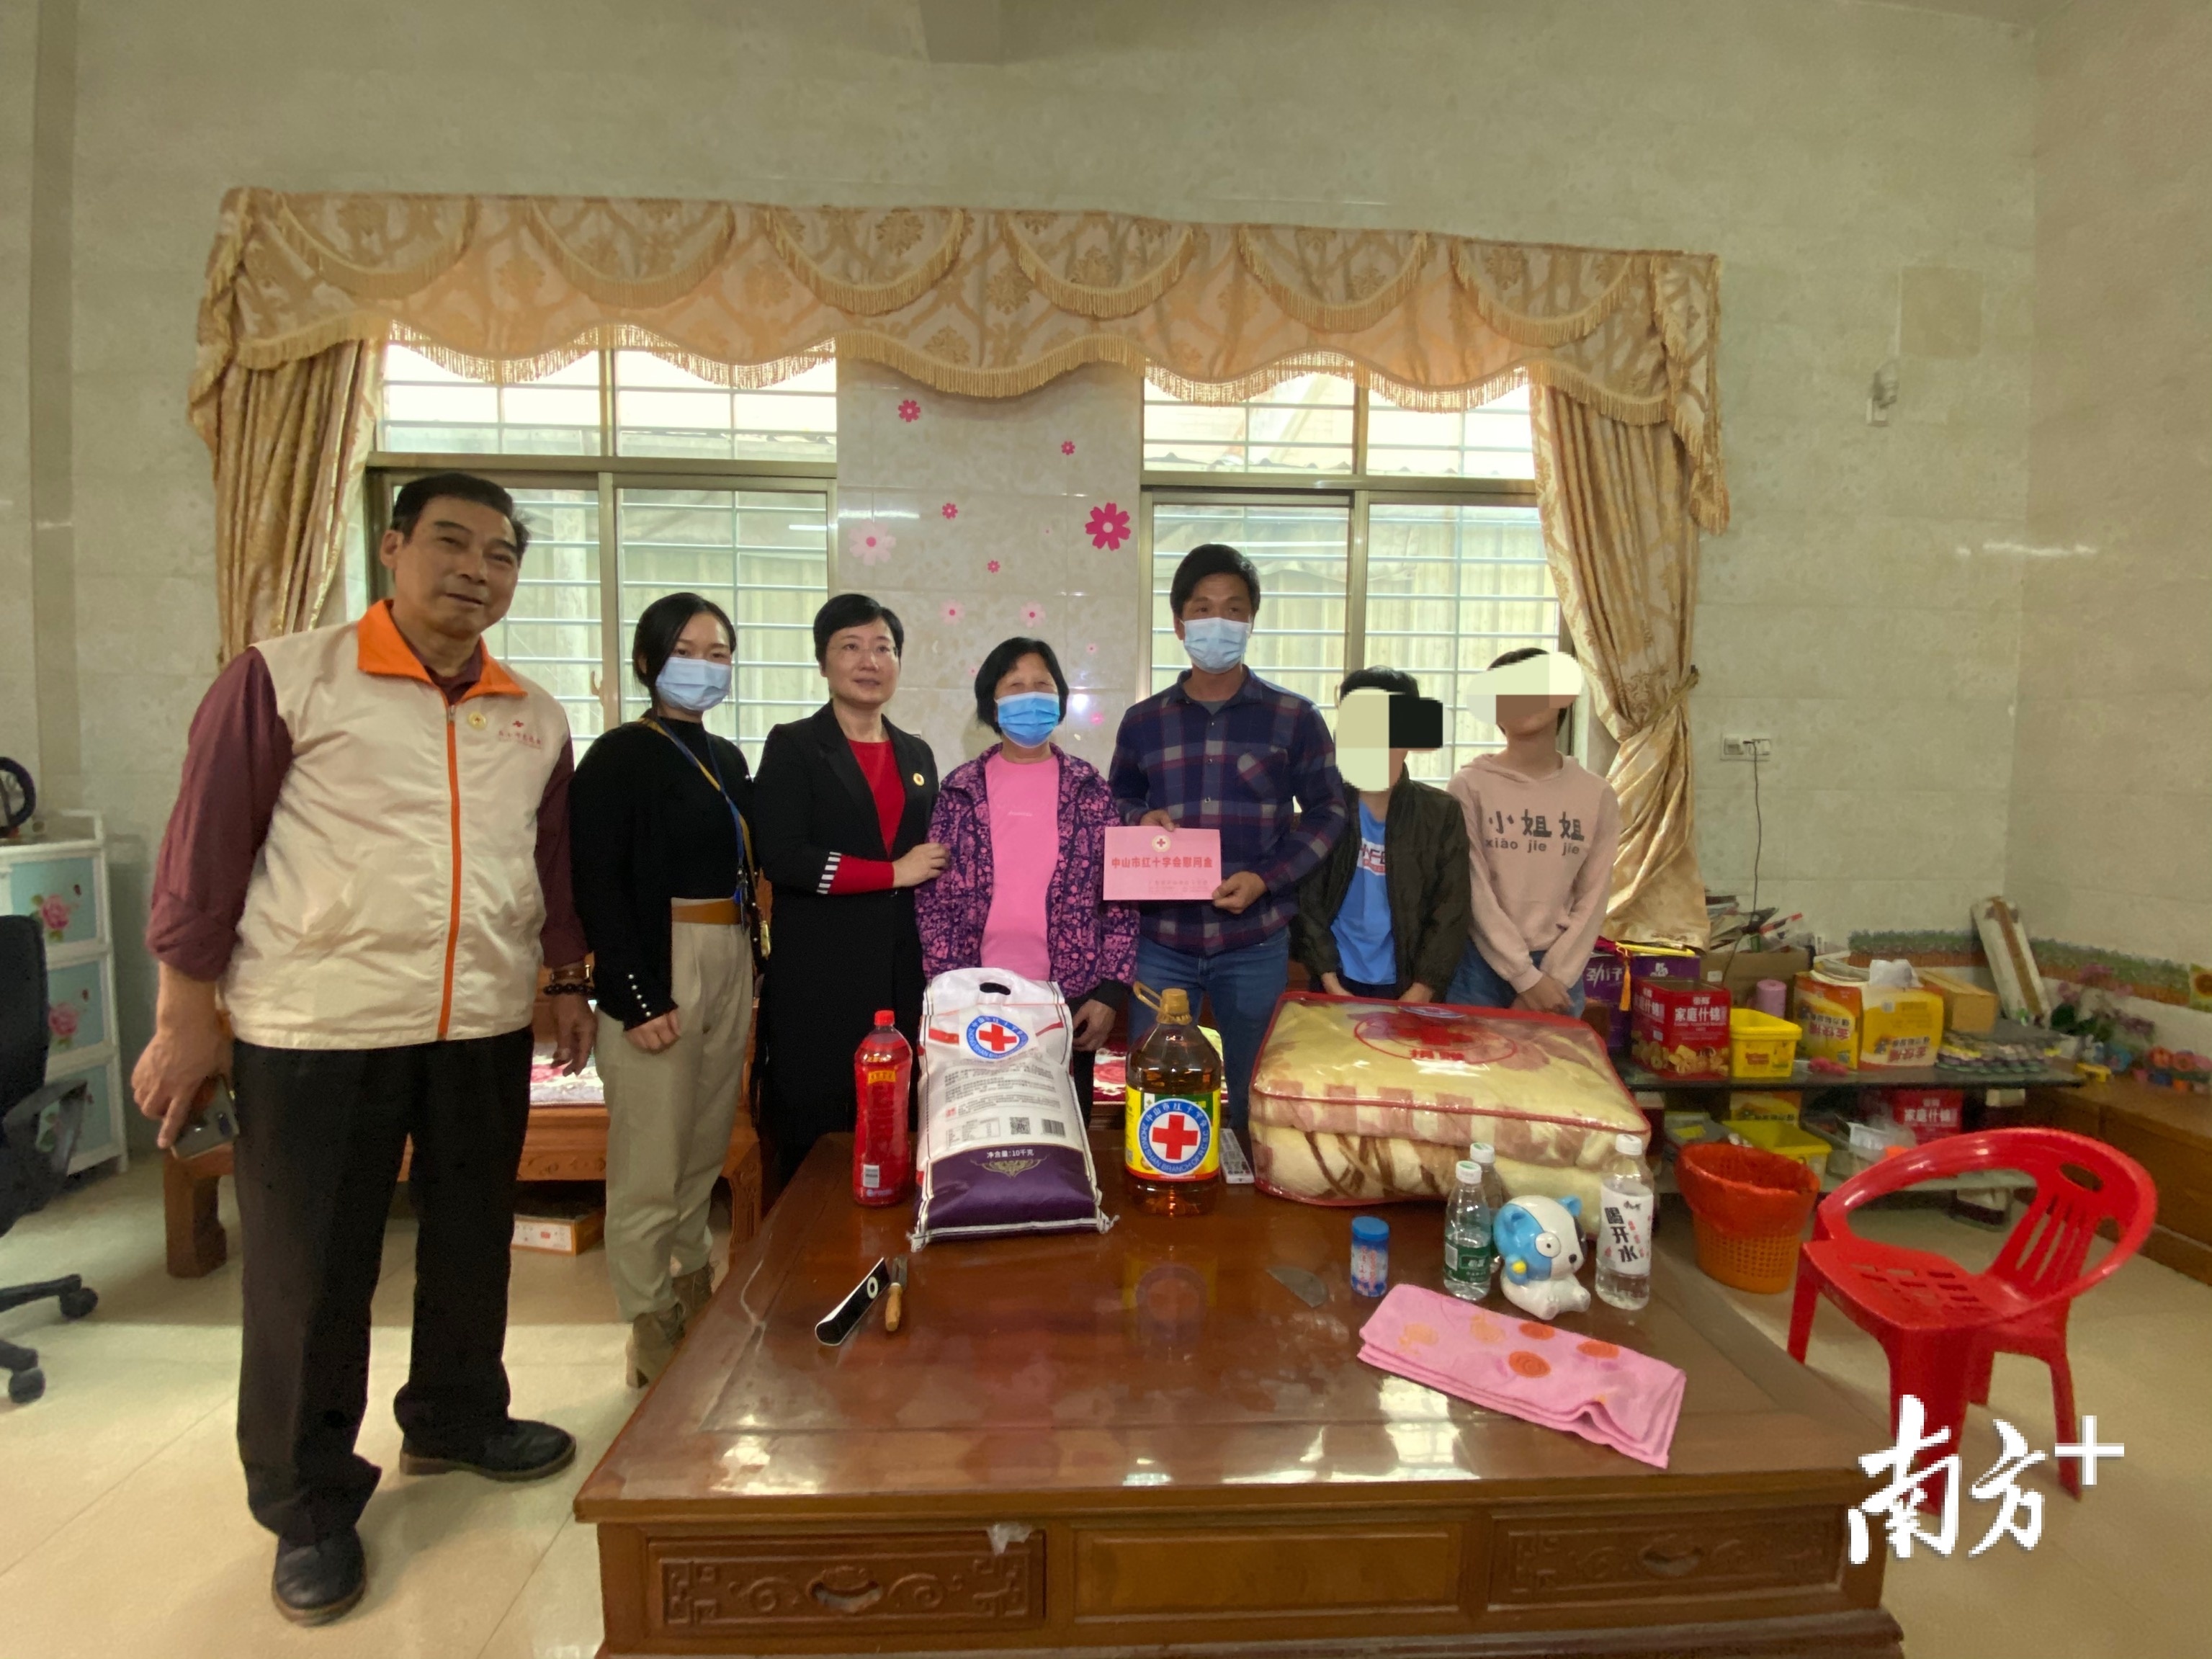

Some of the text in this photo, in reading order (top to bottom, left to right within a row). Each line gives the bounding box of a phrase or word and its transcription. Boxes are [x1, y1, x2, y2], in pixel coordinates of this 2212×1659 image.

[1488, 808, 1585, 841] 小姐姐
[1111, 856, 1213, 869] 中山市红十字会慰问金
[1675, 1007, 1720, 1021] 家庭什锦
[1145, 1102, 1207, 1127] 中山市红十字会
